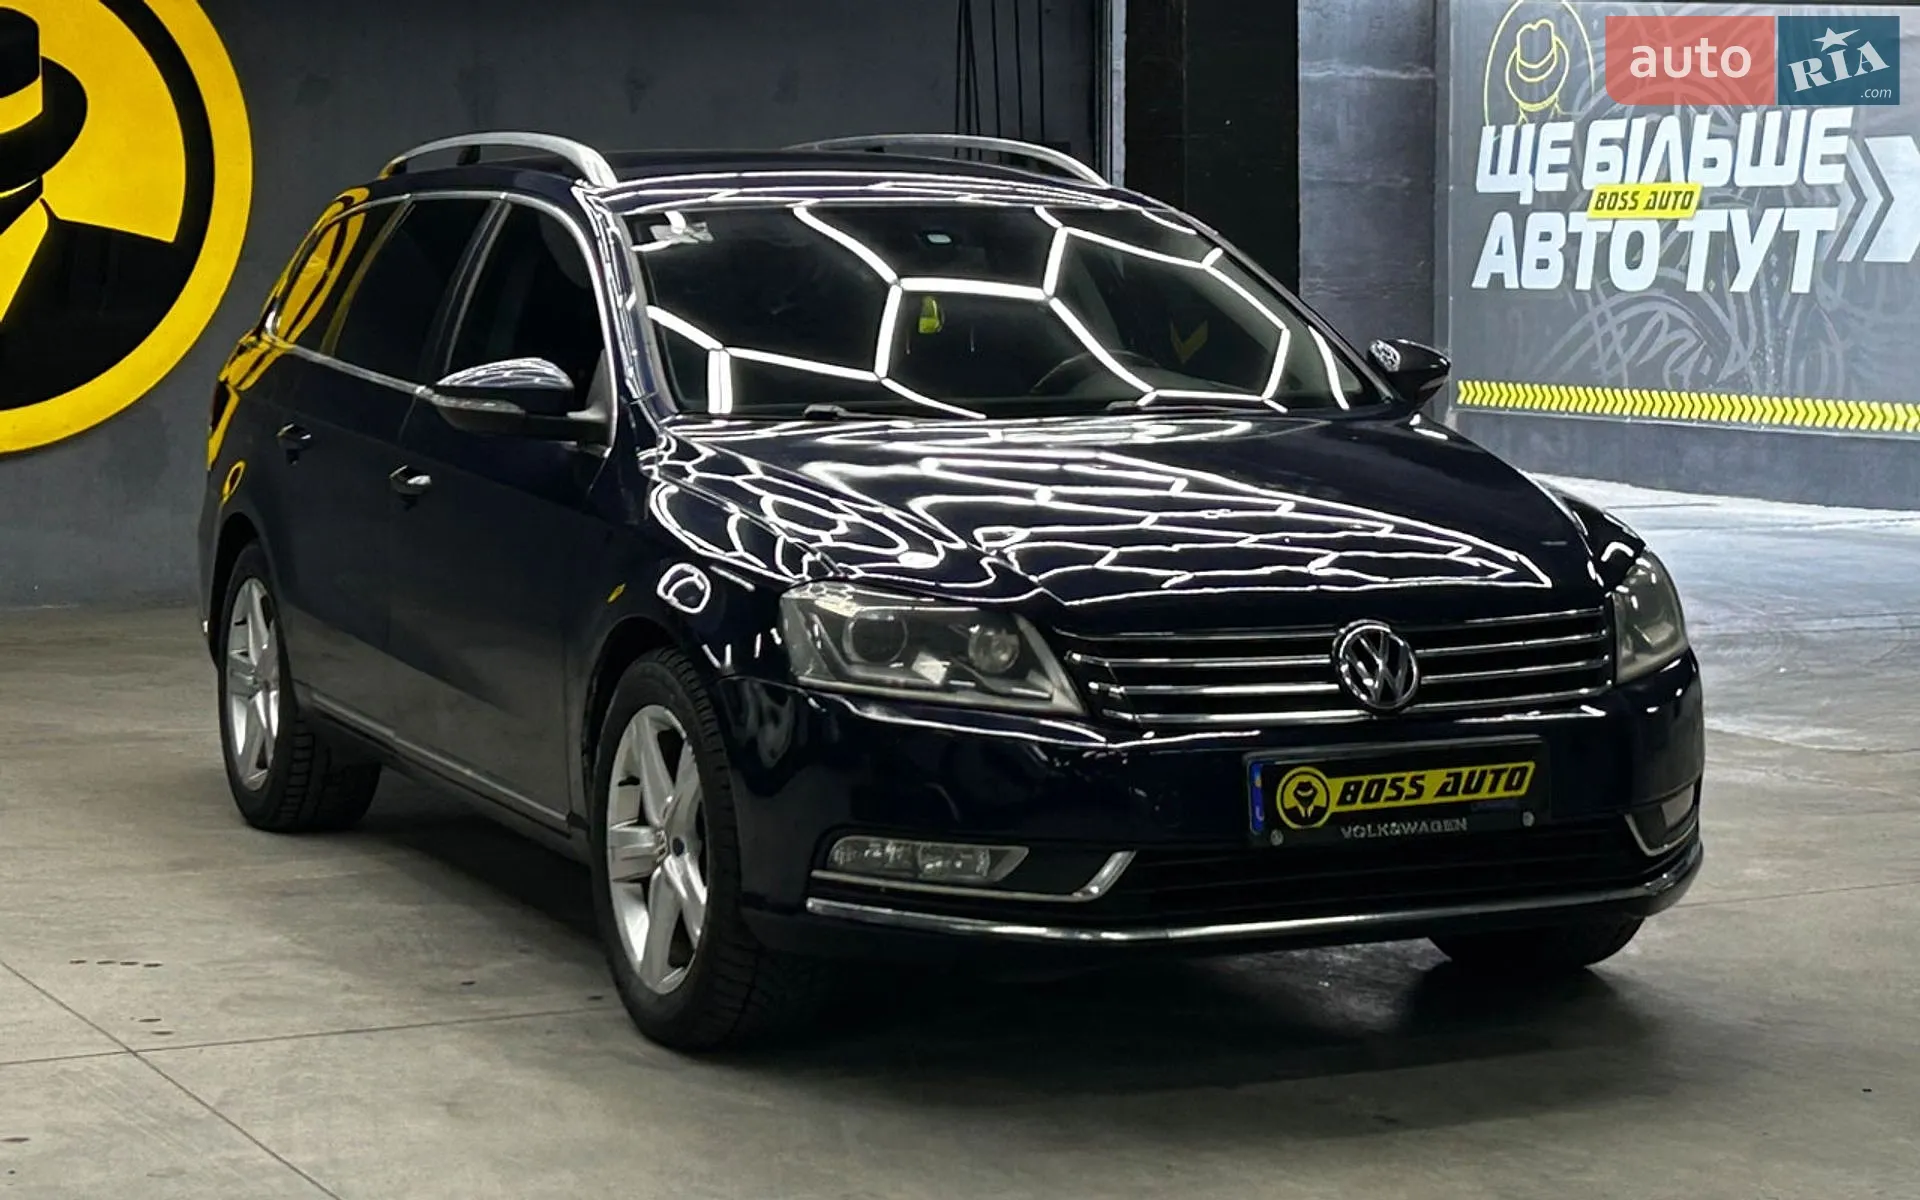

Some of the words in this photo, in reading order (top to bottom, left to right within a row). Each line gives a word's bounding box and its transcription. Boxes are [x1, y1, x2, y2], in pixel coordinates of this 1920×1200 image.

[1476, 121, 1575, 205] ЩЕ
[1582, 107, 1854, 190] БІЛЬШЕ
[1594, 190, 1639, 211] BOSS
[1643, 189, 1696, 210] AUTO
[1471, 210, 1661, 292] АВТО
[1676, 207, 1838, 294] ТУТ
[1336, 774, 1426, 807] BOSS
[1434, 765, 1529, 799] AUTO
